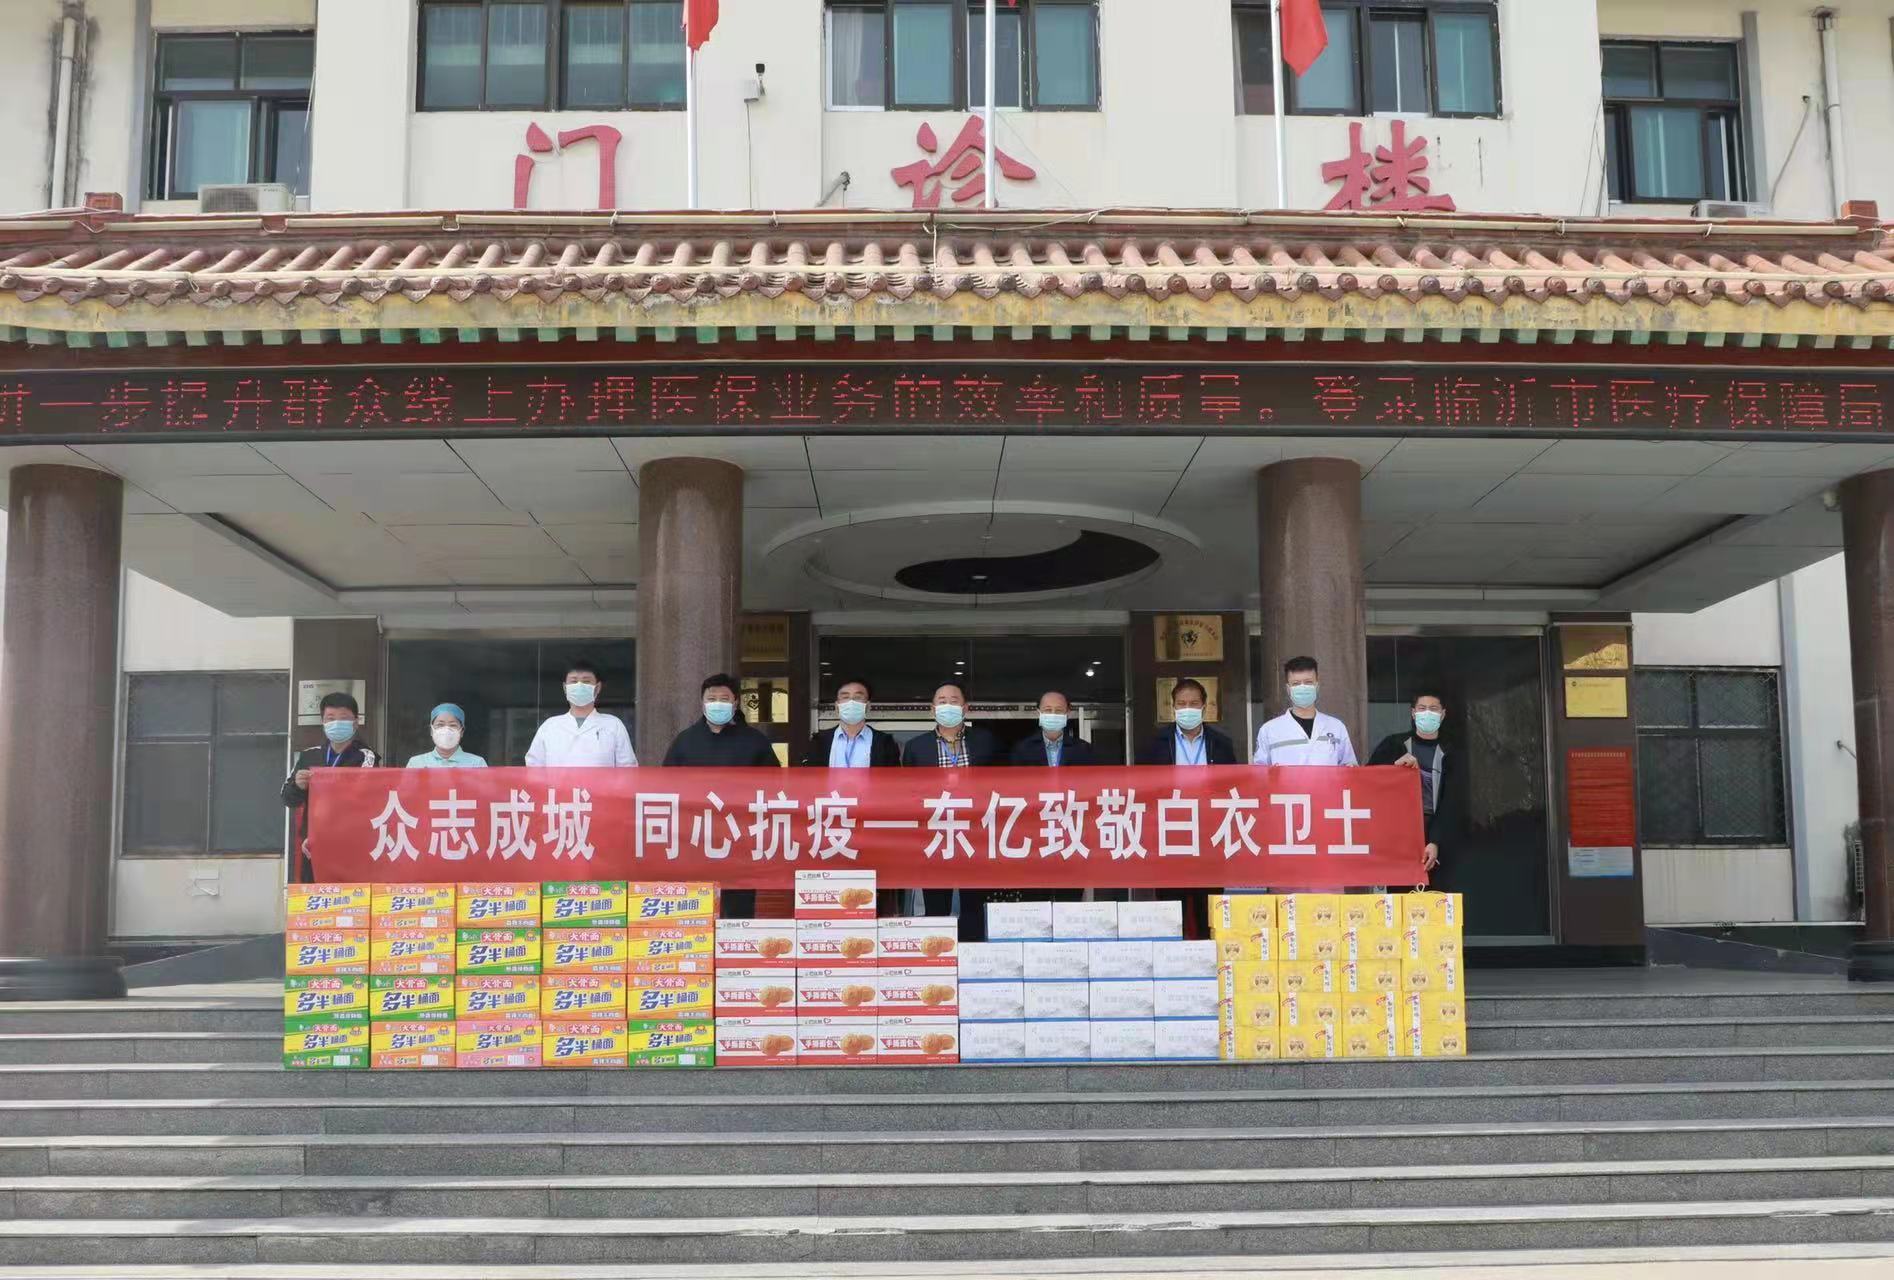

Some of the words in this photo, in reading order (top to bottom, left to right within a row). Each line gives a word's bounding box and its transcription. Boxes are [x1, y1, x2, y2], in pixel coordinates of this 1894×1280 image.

[514, 114, 1456, 211] 门诊楼
[369, 788, 596, 863] 众志成城
